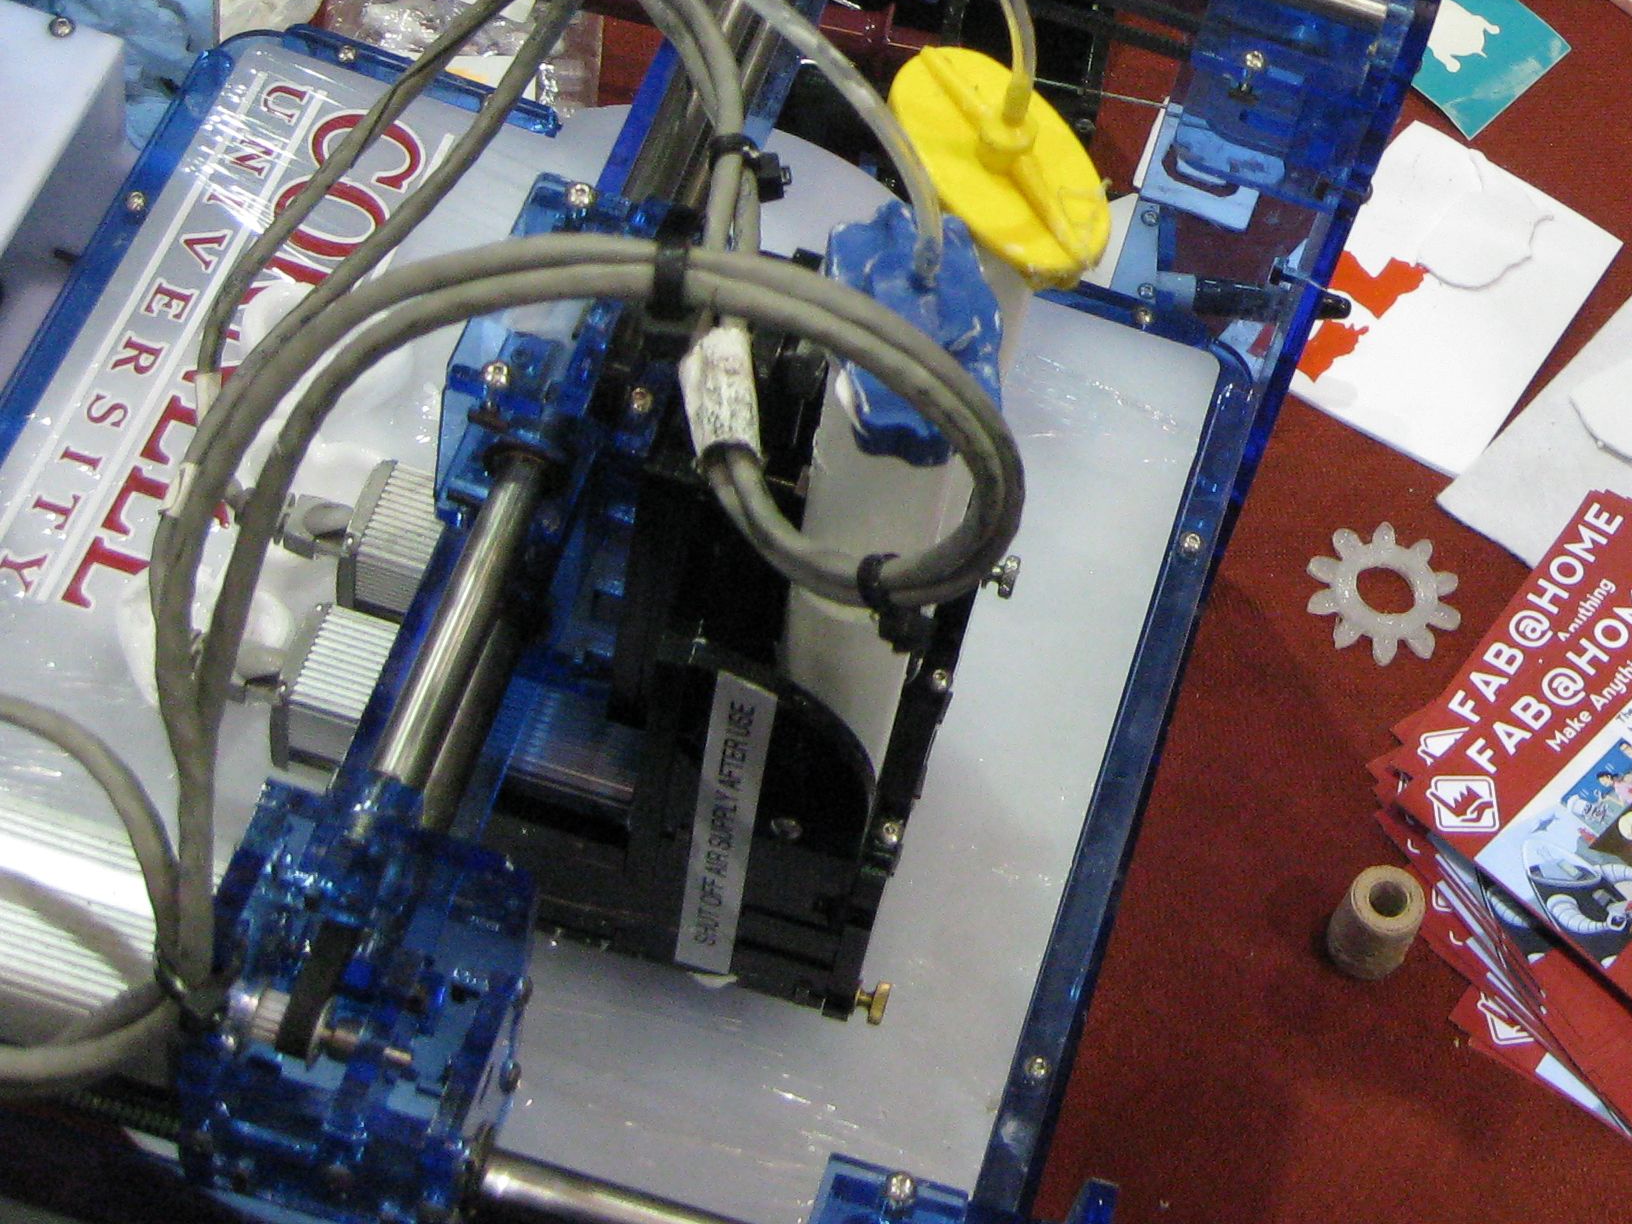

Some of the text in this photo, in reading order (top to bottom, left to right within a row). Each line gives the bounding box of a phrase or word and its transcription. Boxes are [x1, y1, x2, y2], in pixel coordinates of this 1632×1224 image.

[0, 84, 308, 593] UNIVERSITY
[1448, 502, 1623, 723] FAB@HOME
[727, 699, 755, 736] USE
[1545, 709, 1593, 752] Make
[718, 736, 749, 791] AFTER
[709, 788, 740, 851] SUPPLY
[704, 849, 730, 878] AIR
[700, 876, 726, 907] OFF
